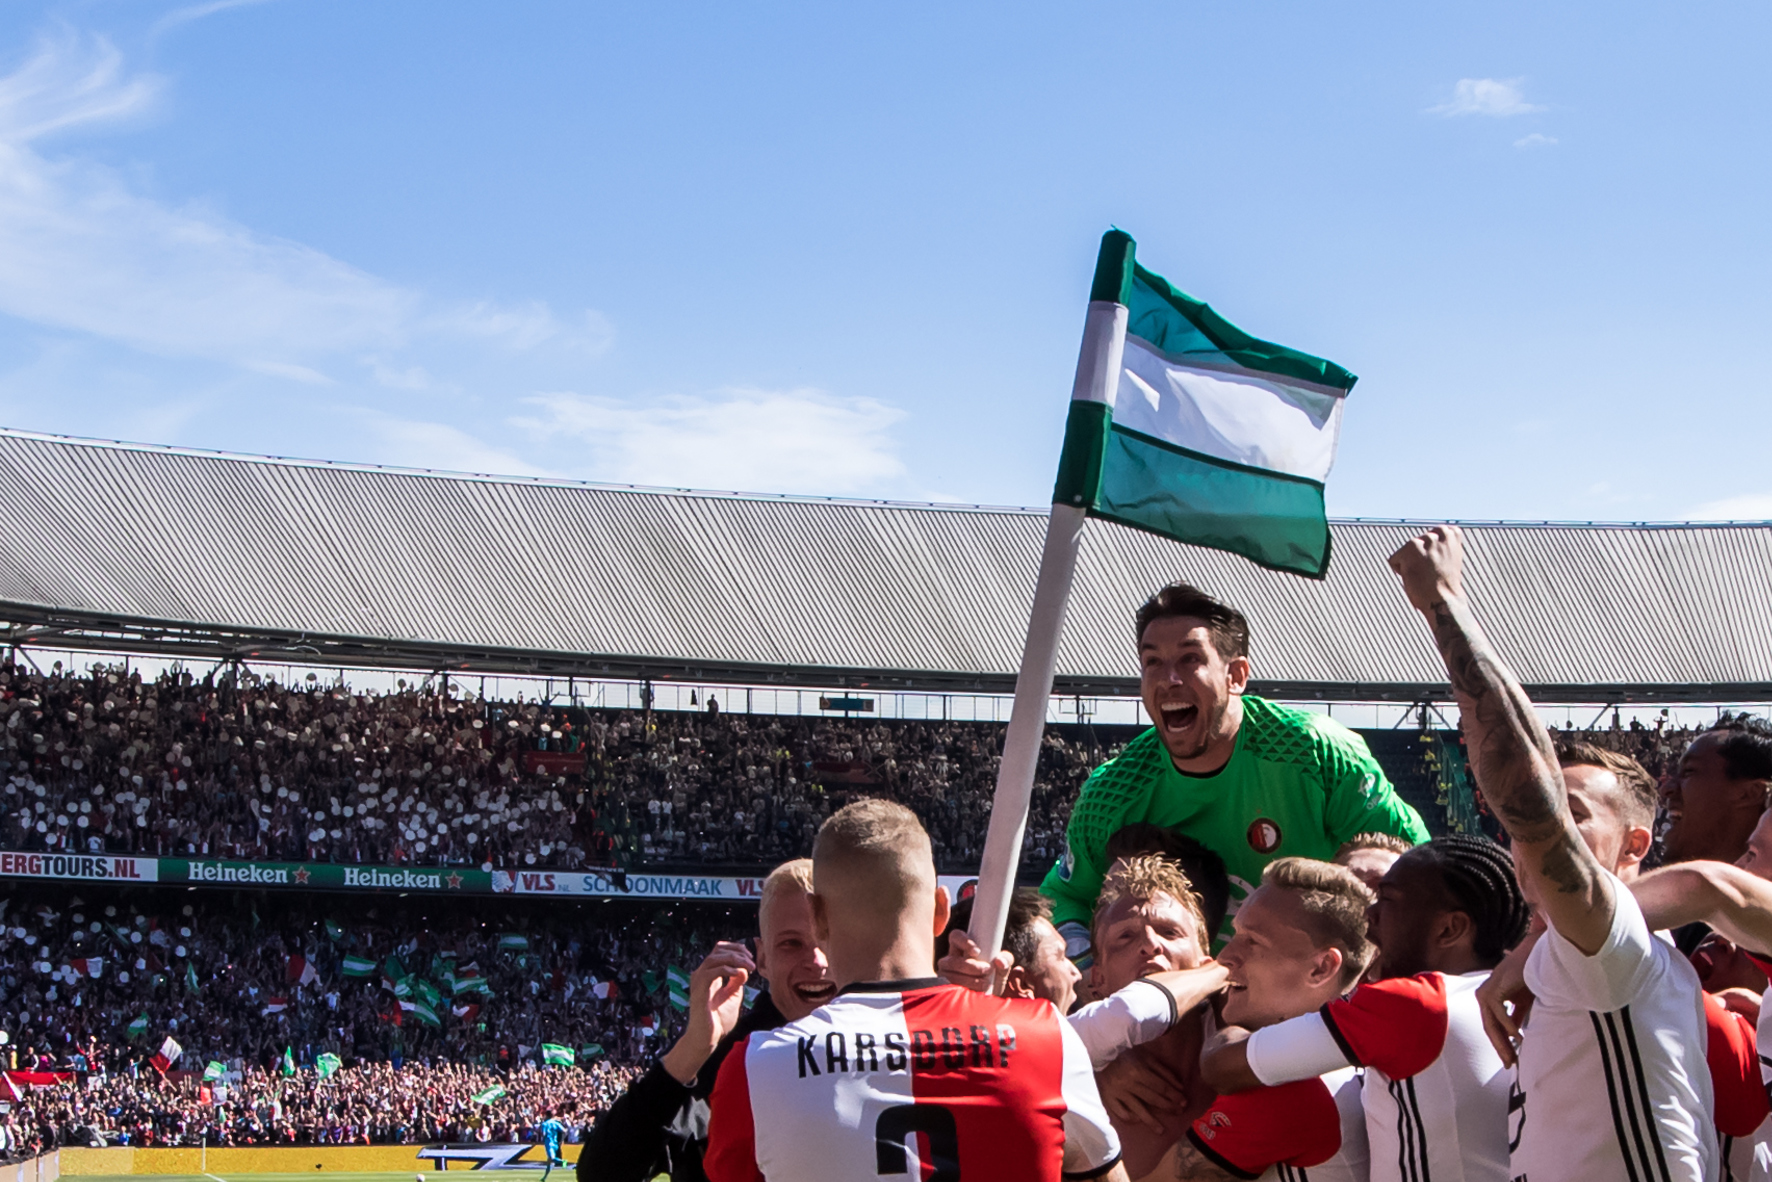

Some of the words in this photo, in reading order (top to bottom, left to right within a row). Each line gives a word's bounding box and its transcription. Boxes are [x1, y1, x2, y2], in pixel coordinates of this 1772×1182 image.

[1, 854, 140, 878] ERGTOURS.NL
[188, 861, 288, 884] Heineken
[344, 867, 441, 889] Heineken
[797, 1024, 1017, 1078] KARSDORP
